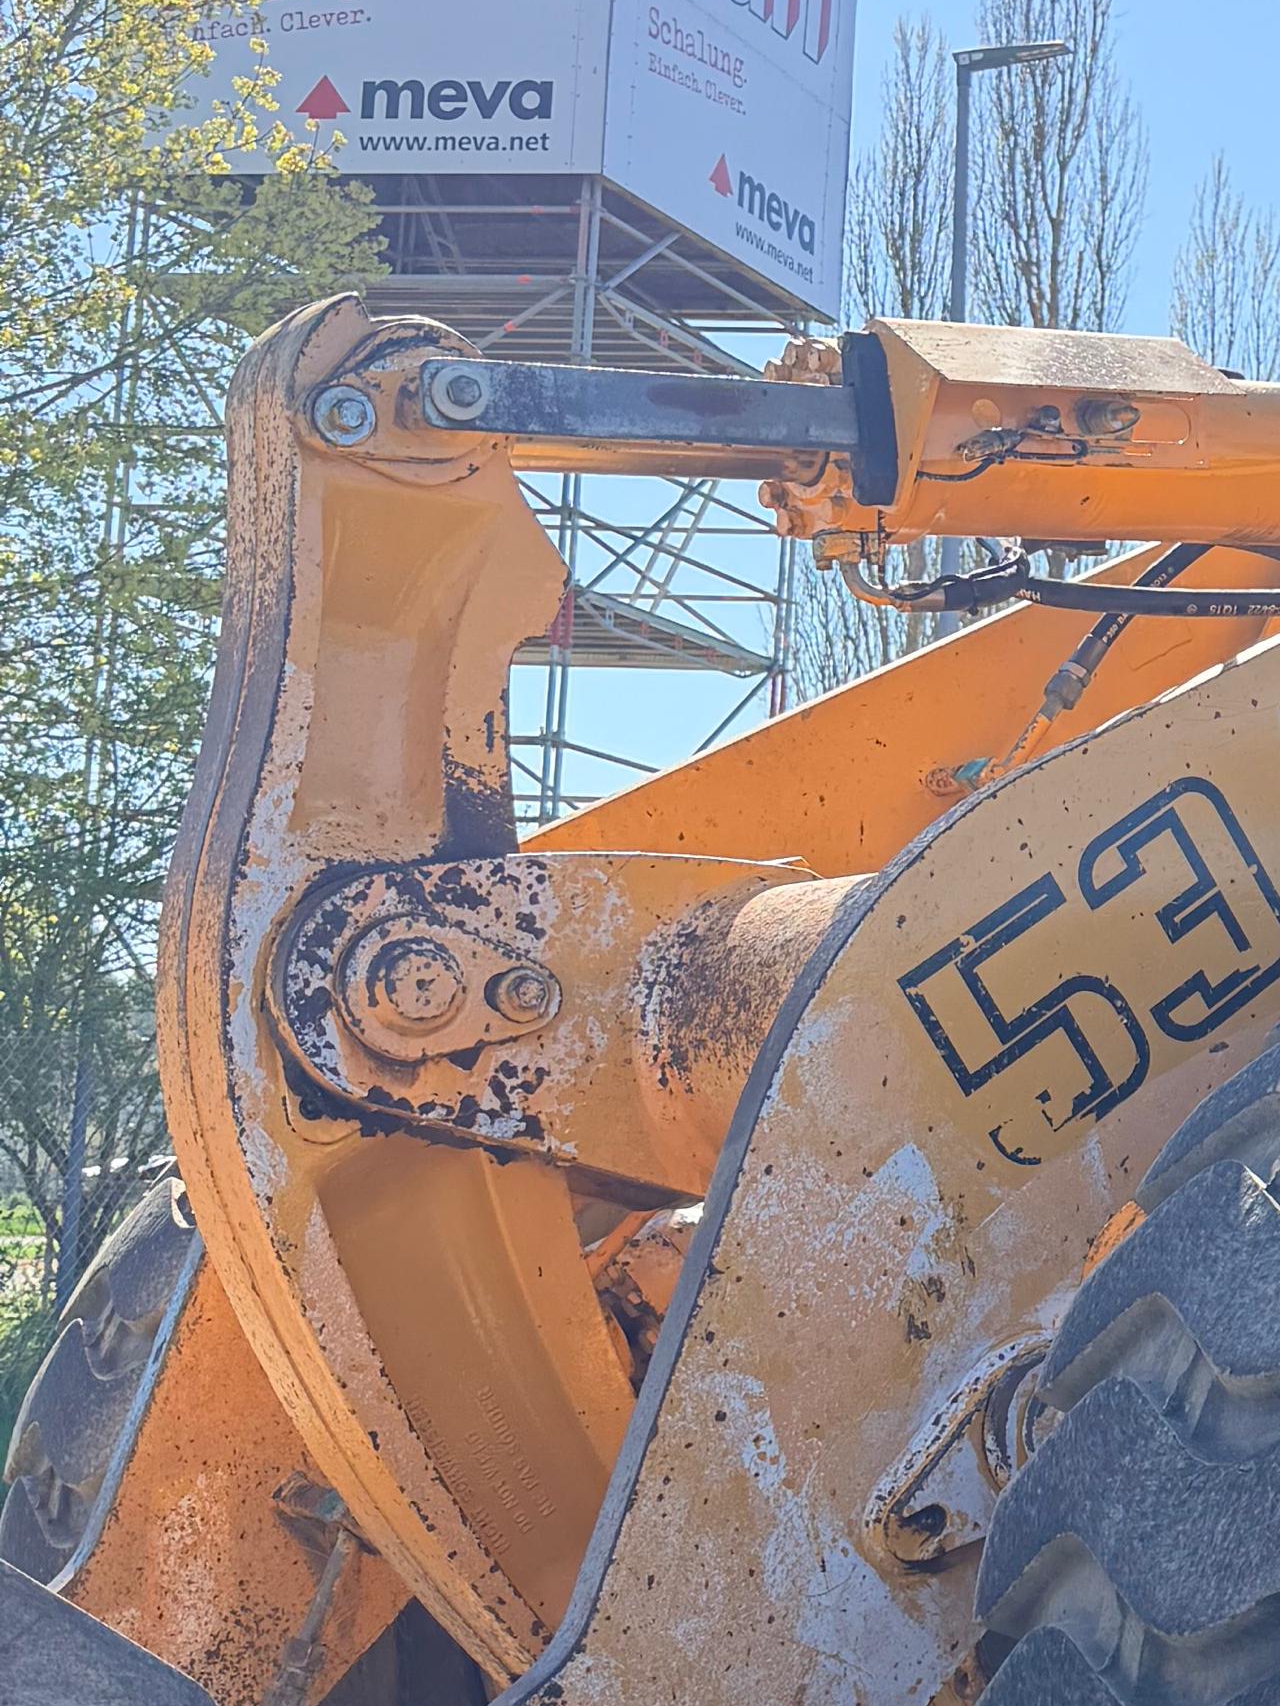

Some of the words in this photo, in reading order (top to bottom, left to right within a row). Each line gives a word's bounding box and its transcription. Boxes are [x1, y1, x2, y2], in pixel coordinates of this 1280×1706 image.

[281, 8, 371, 33] Clever.
[648, 6, 747, 88] Schalung.
[360, 79, 553, 120] meva
[705, 79, 746, 115] Clever.
[359, 131, 550, 151] www.meva.net
[737, 170, 815, 256] meva
[735, 221, 813, 285] www.meva.net
